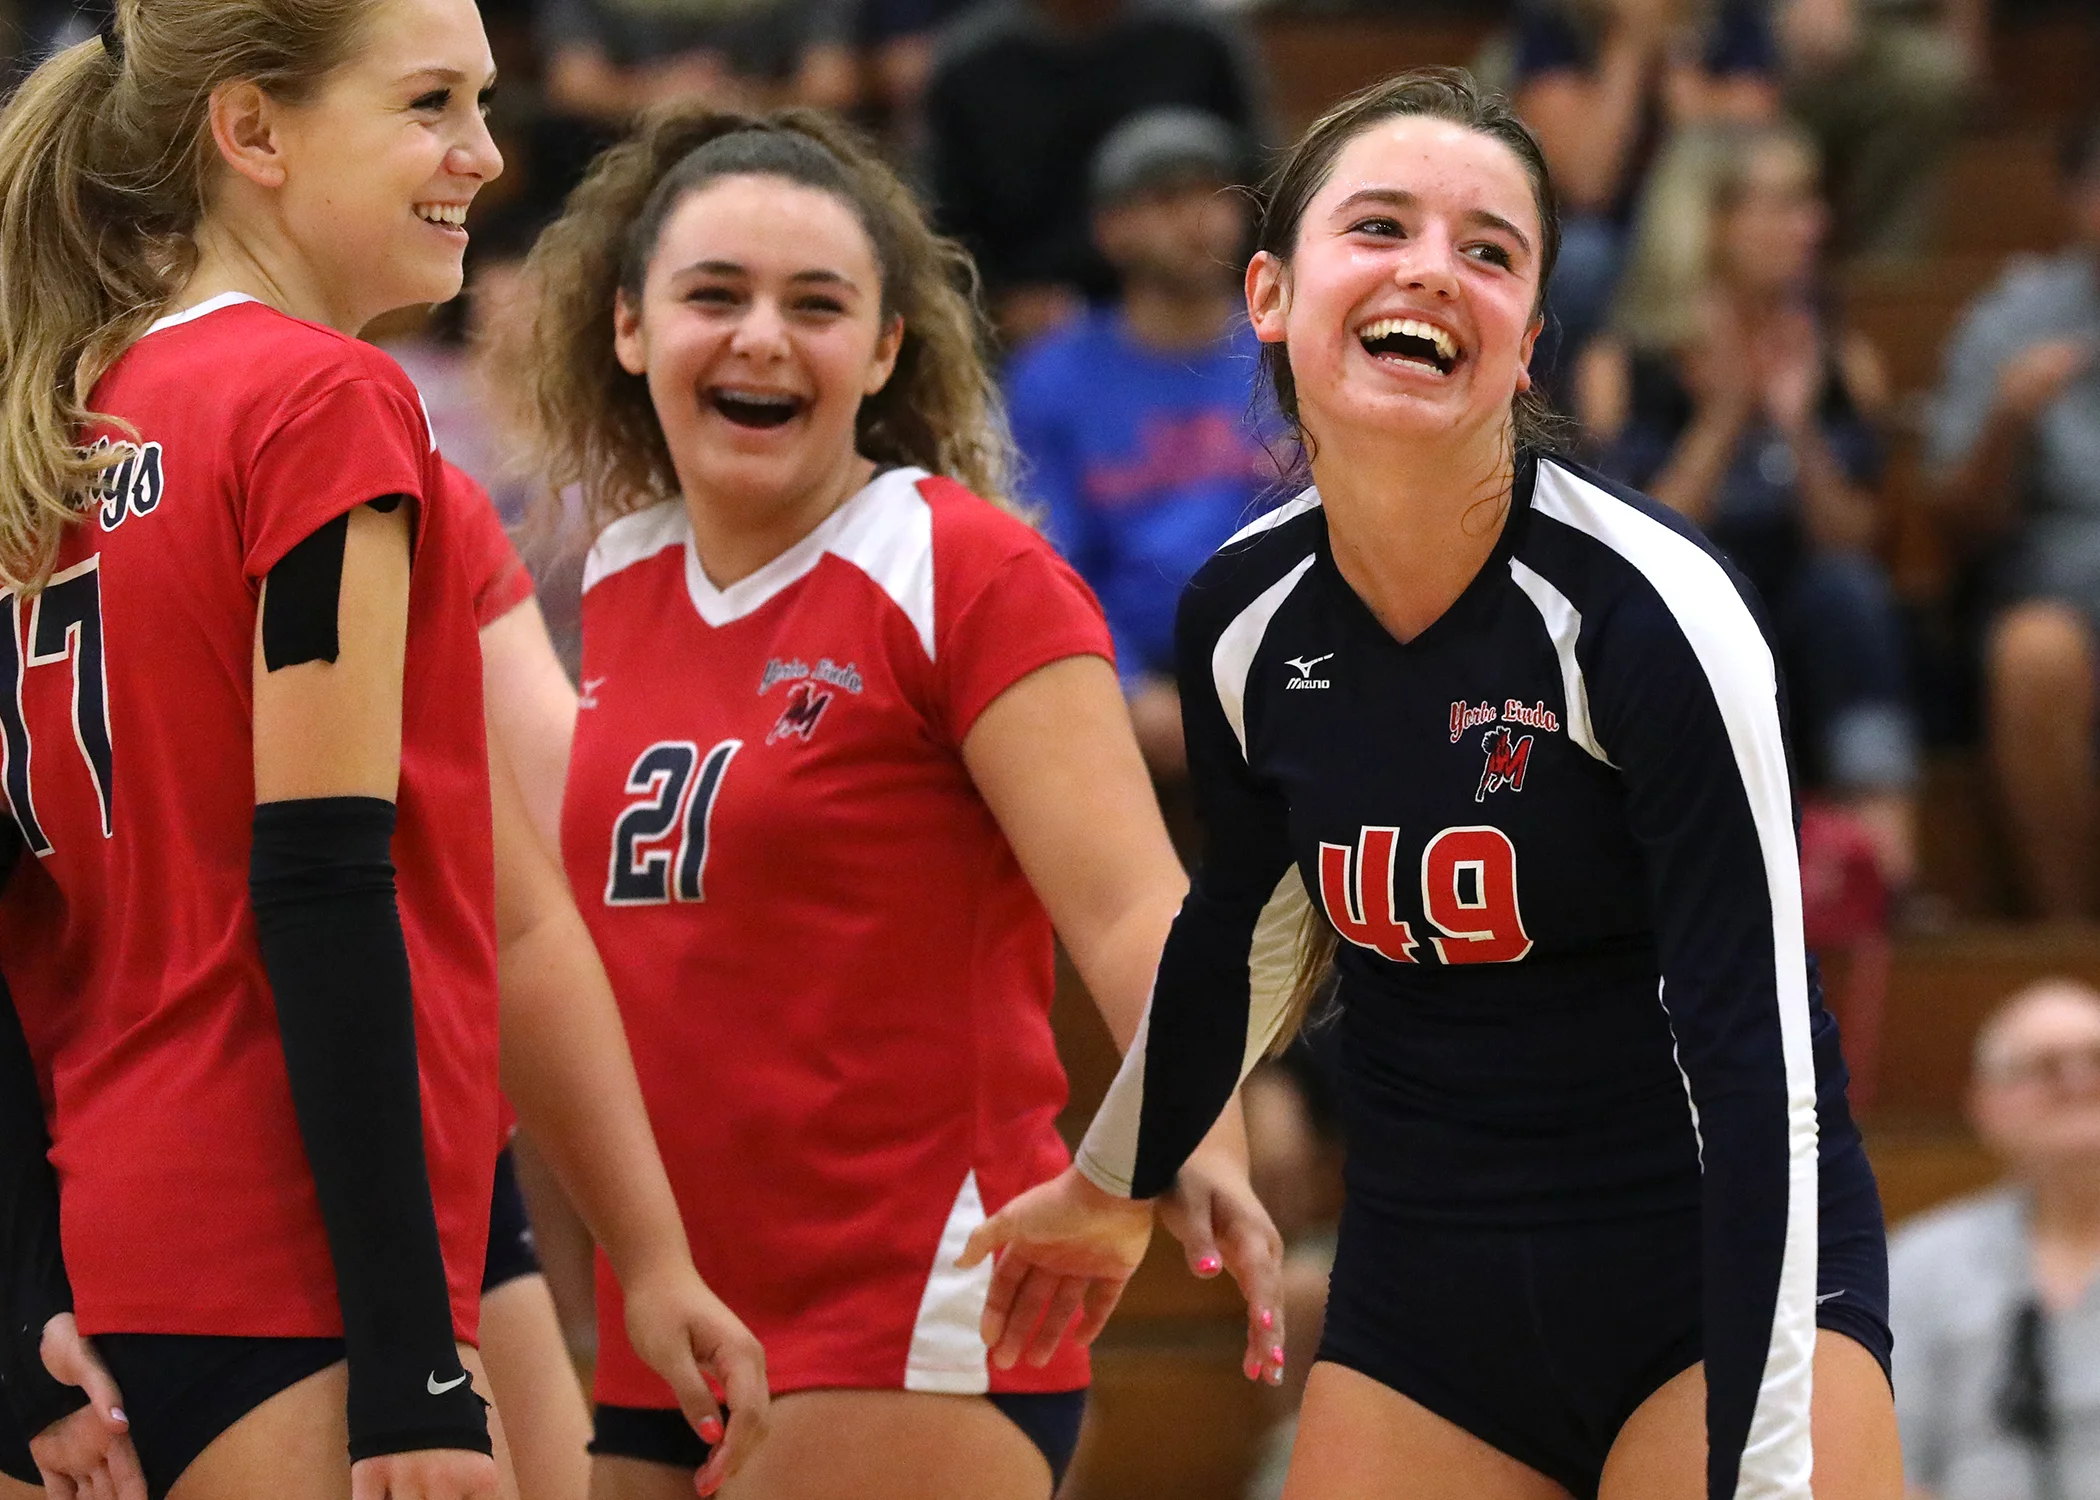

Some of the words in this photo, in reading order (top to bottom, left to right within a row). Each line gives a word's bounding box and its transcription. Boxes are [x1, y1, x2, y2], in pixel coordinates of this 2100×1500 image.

[0, 551, 113, 858] 17
[1449, 700, 1497, 743] Yorba
[1501, 698, 1560, 732] Linda
[604, 739, 743, 907] 21
[1319, 825, 1534, 965] 49
